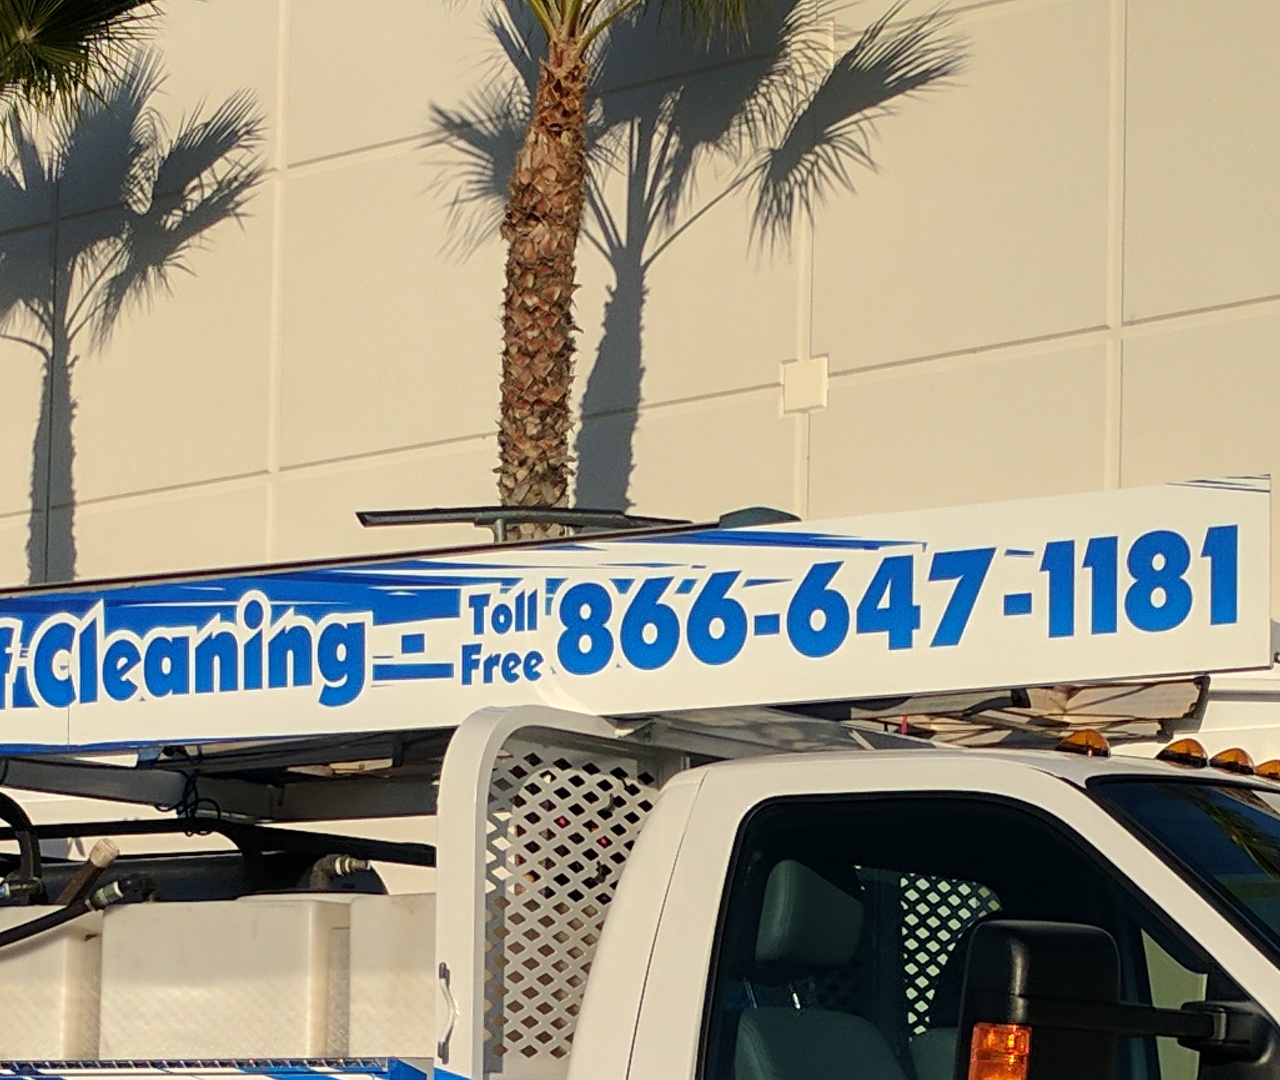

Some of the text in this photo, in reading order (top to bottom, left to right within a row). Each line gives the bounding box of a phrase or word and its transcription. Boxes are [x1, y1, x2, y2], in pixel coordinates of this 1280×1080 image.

[467, 585, 539, 637] Toll
[555, 524, 1240, 676] 866-647-1181
[30, 598, 366, 708] Cleaning
[460, 640, 545, 687] Free
